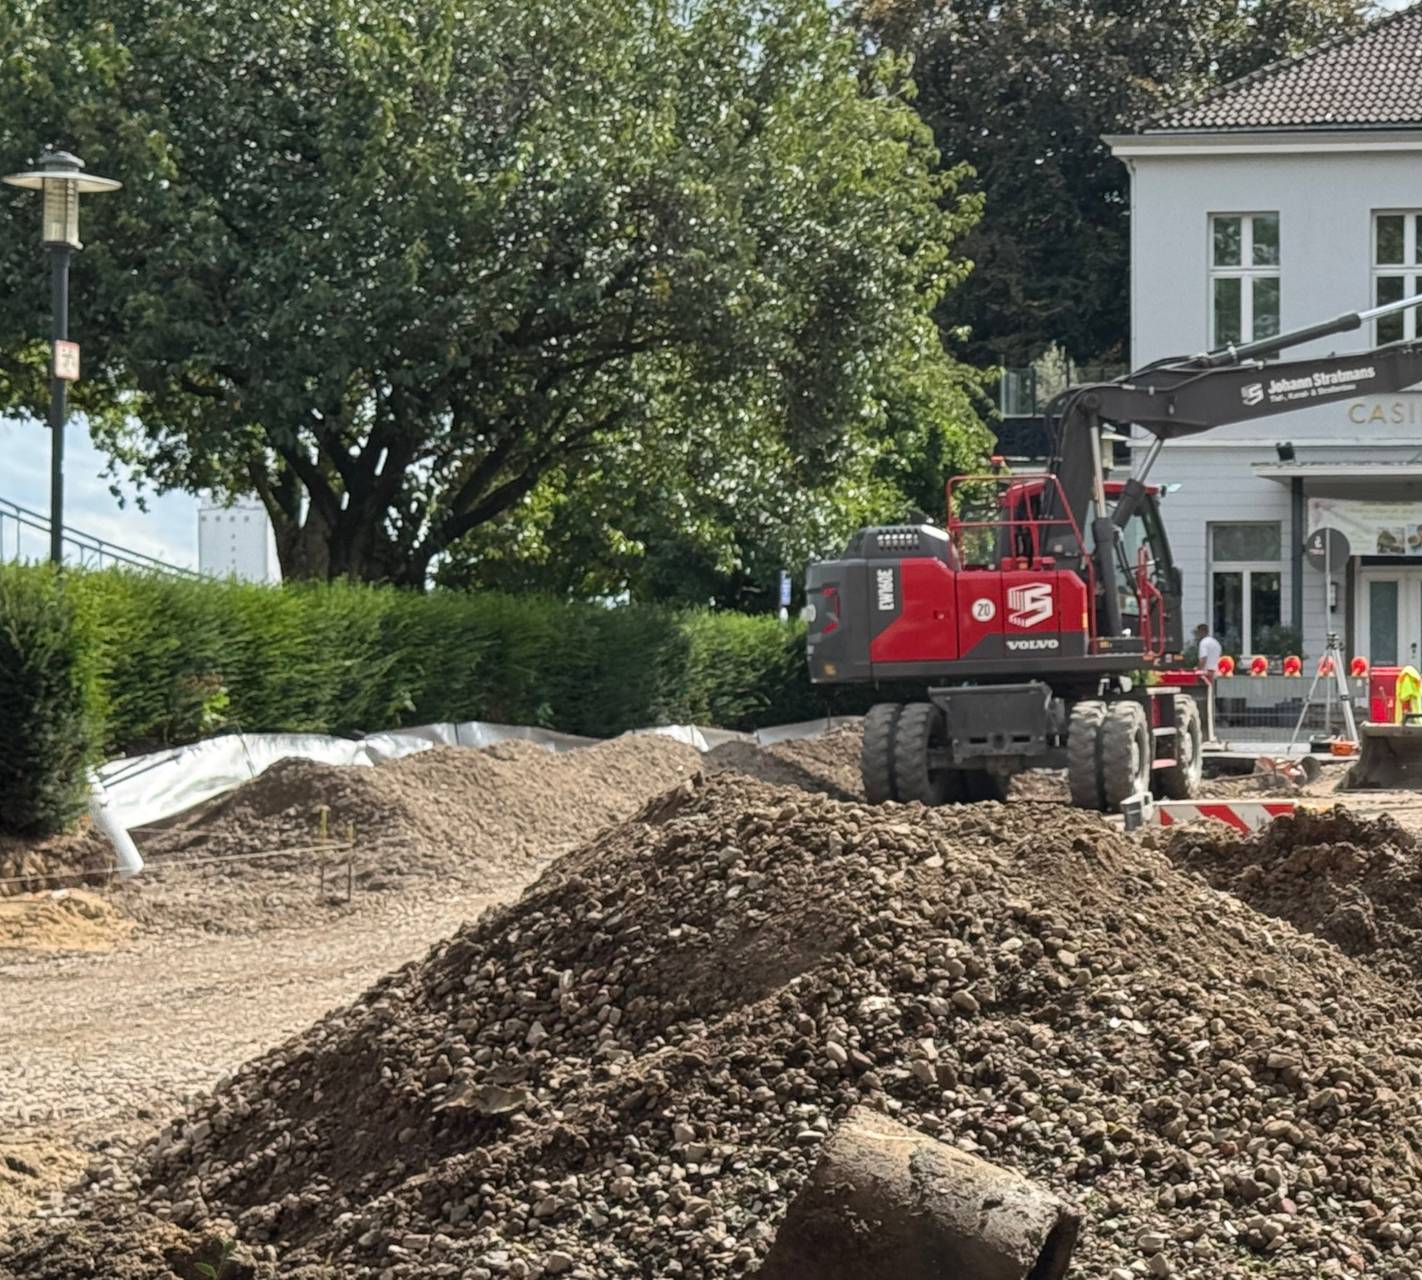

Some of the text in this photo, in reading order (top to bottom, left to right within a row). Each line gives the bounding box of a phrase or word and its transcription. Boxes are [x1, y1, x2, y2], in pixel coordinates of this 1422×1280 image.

[1268, 366, 1376, 394] Johann Stratmans
[877, 568, 895, 611] EW160E
[977, 603, 991, 617] 20
[1006, 639, 1059, 650] VOLVO
